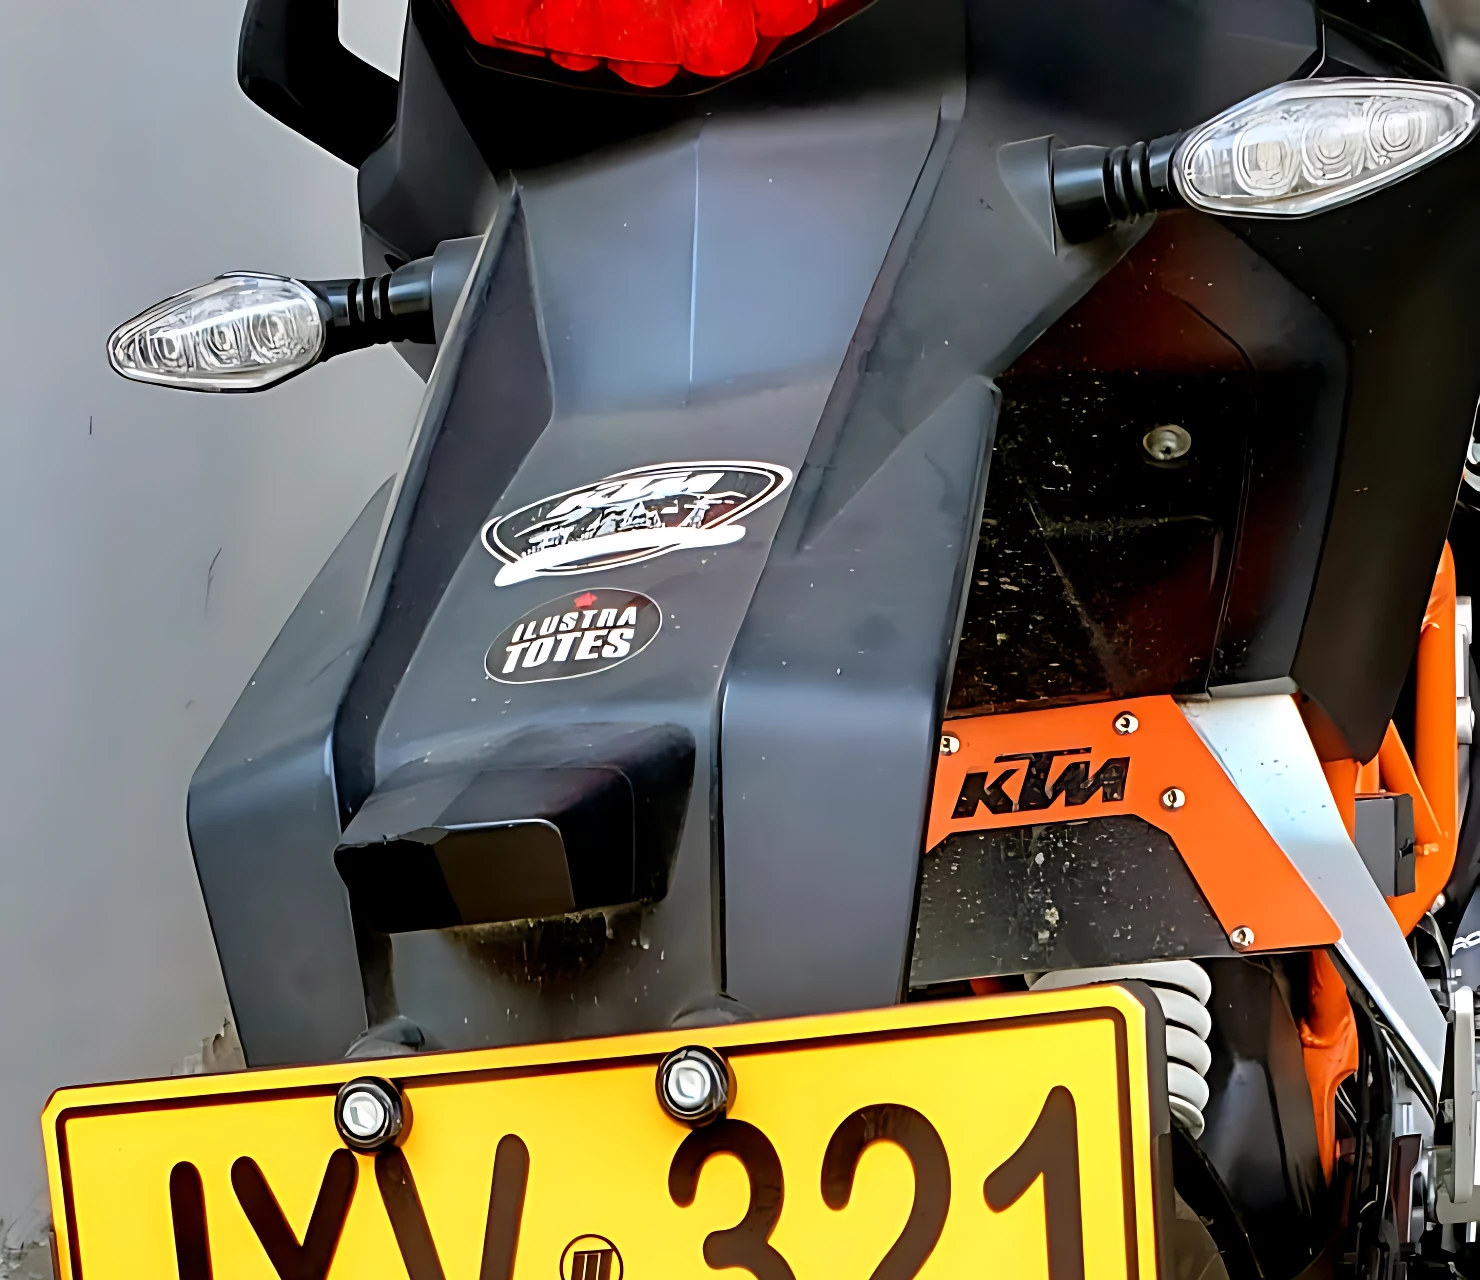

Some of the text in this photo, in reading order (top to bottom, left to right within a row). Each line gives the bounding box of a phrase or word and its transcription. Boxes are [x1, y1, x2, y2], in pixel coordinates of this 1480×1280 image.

[511, 606, 637, 643] ILUSTRA
[502, 628, 635, 674] TOTES
[951, 746, 1130, 819] KTM
